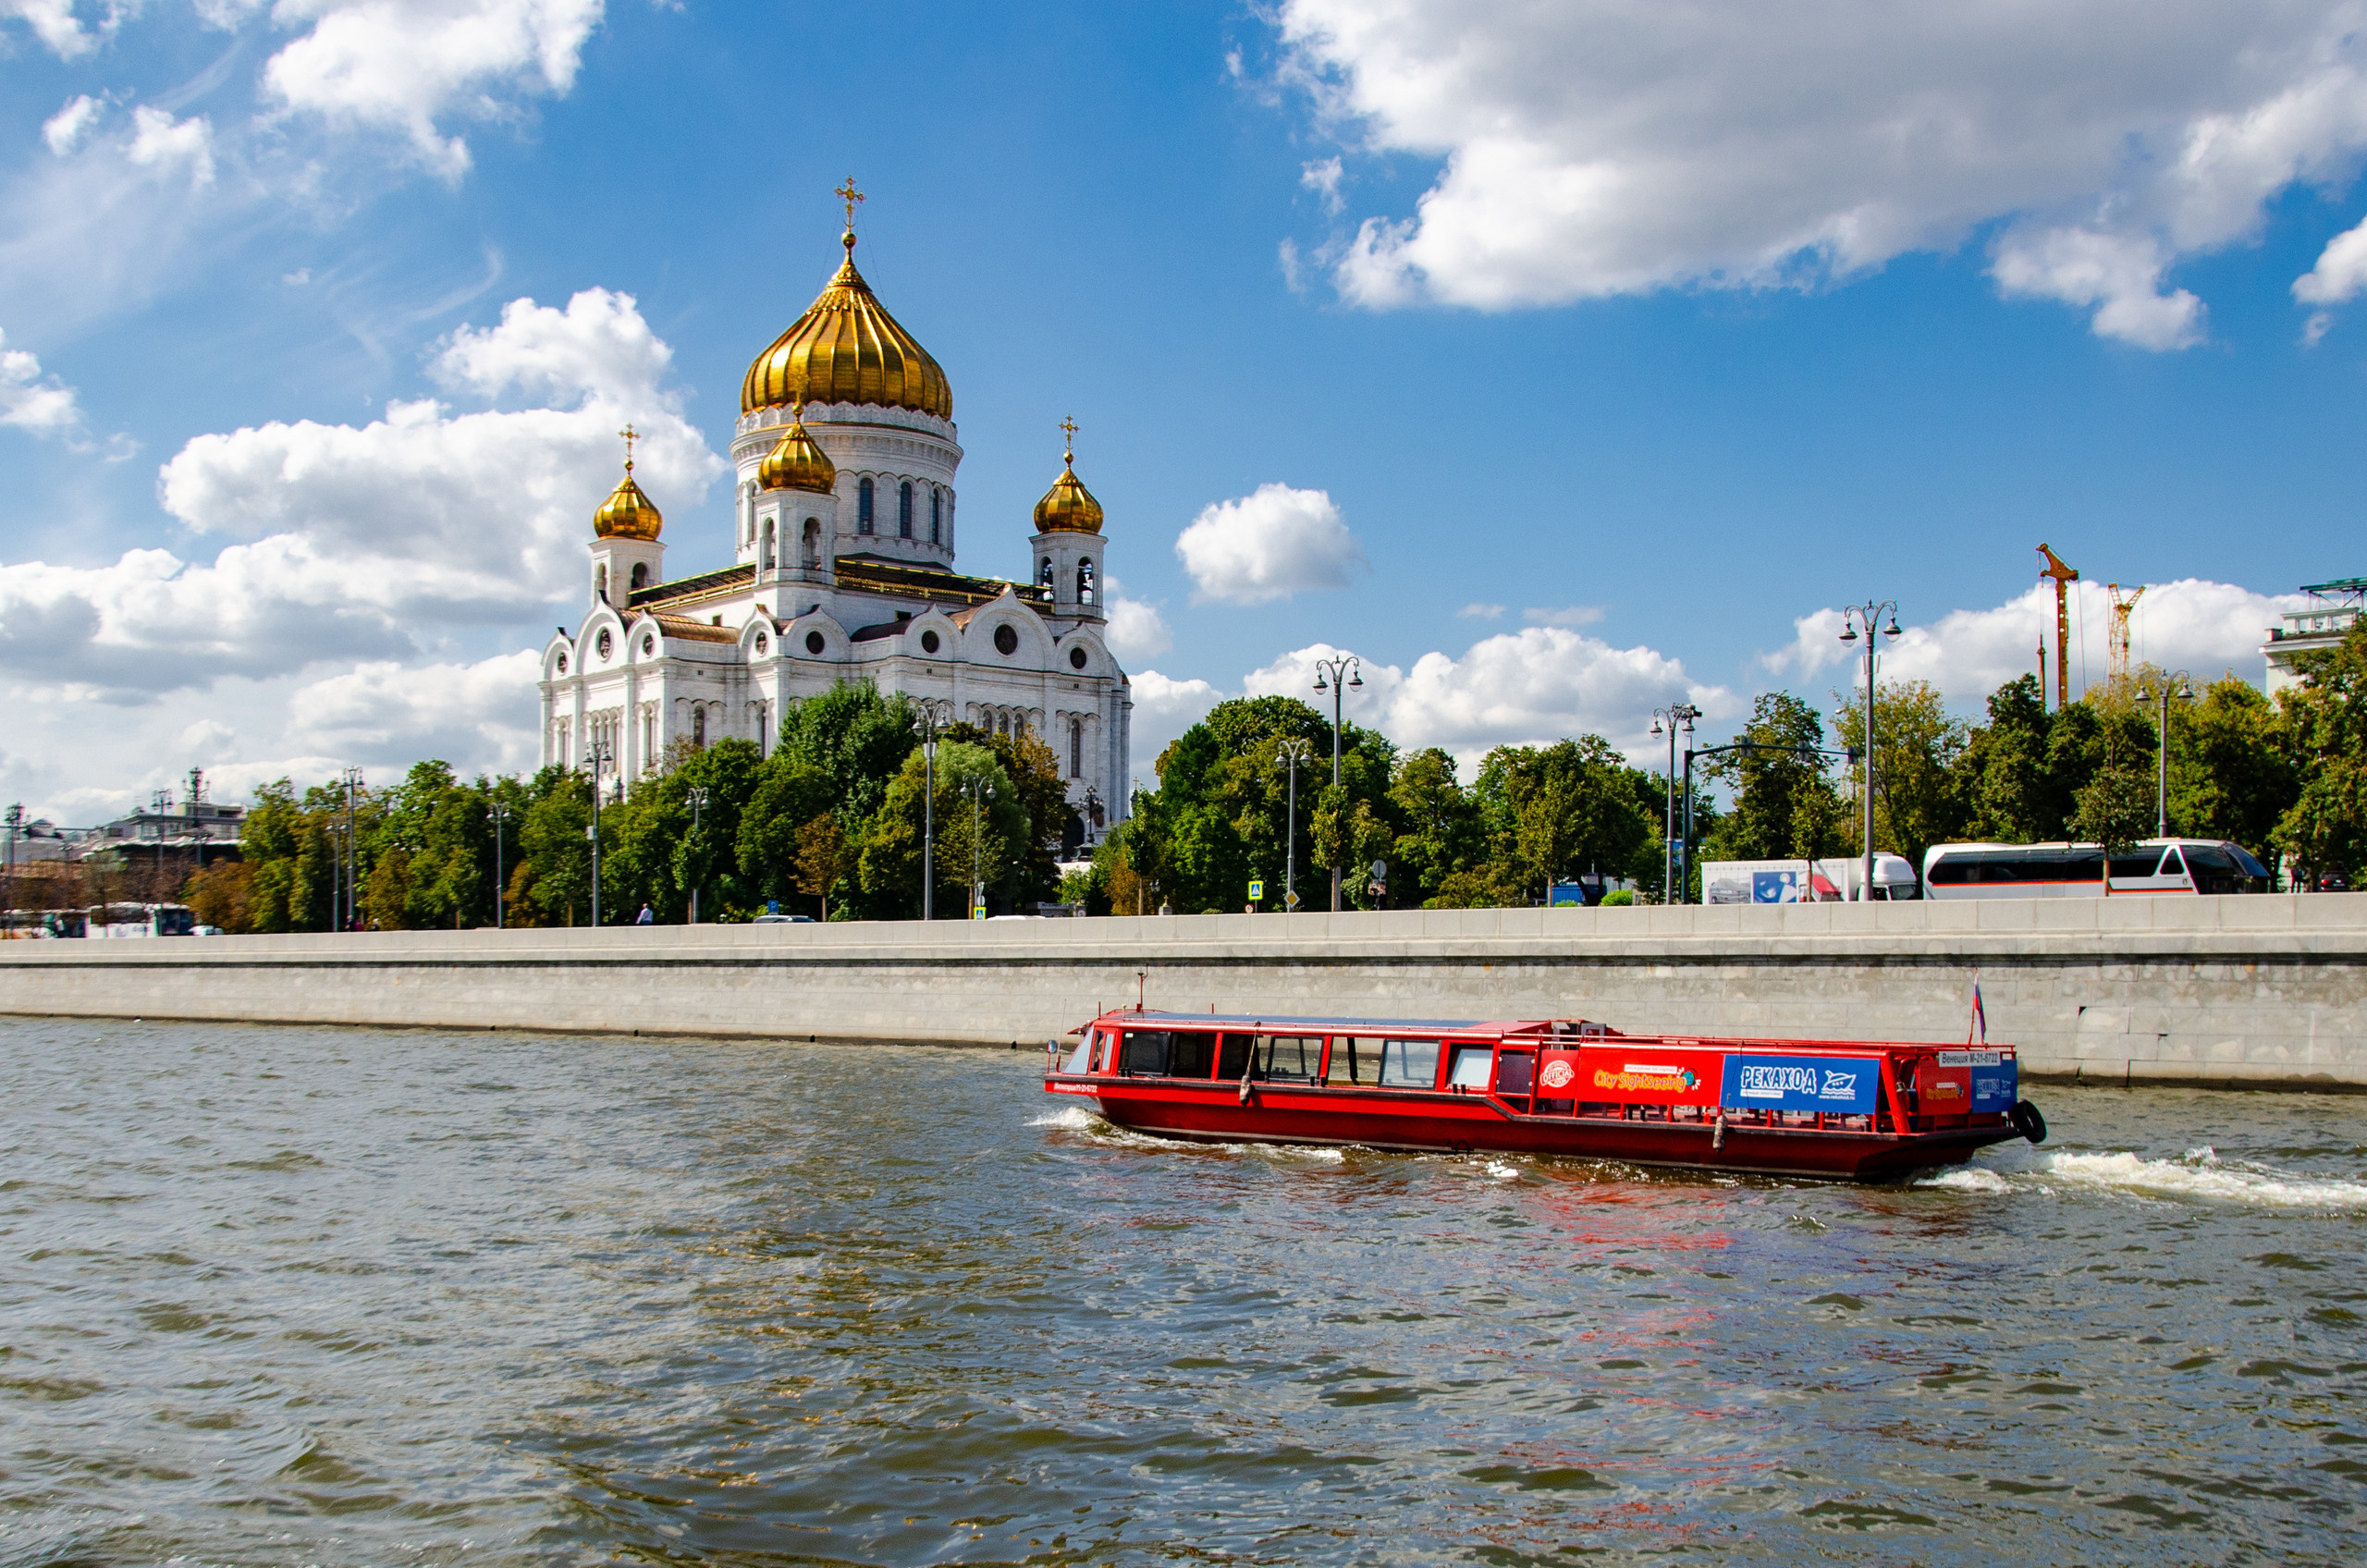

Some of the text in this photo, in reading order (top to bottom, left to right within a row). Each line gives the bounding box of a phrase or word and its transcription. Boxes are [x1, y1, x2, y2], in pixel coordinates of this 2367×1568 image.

[1942, 1053, 1968, 1064] Венеция
[1543, 1070, 1573, 1083] OFFICIAL
[1594, 1070, 1686, 1093] City Sightseeing
[1741, 1066, 1817, 1094] РЕКАХОД
